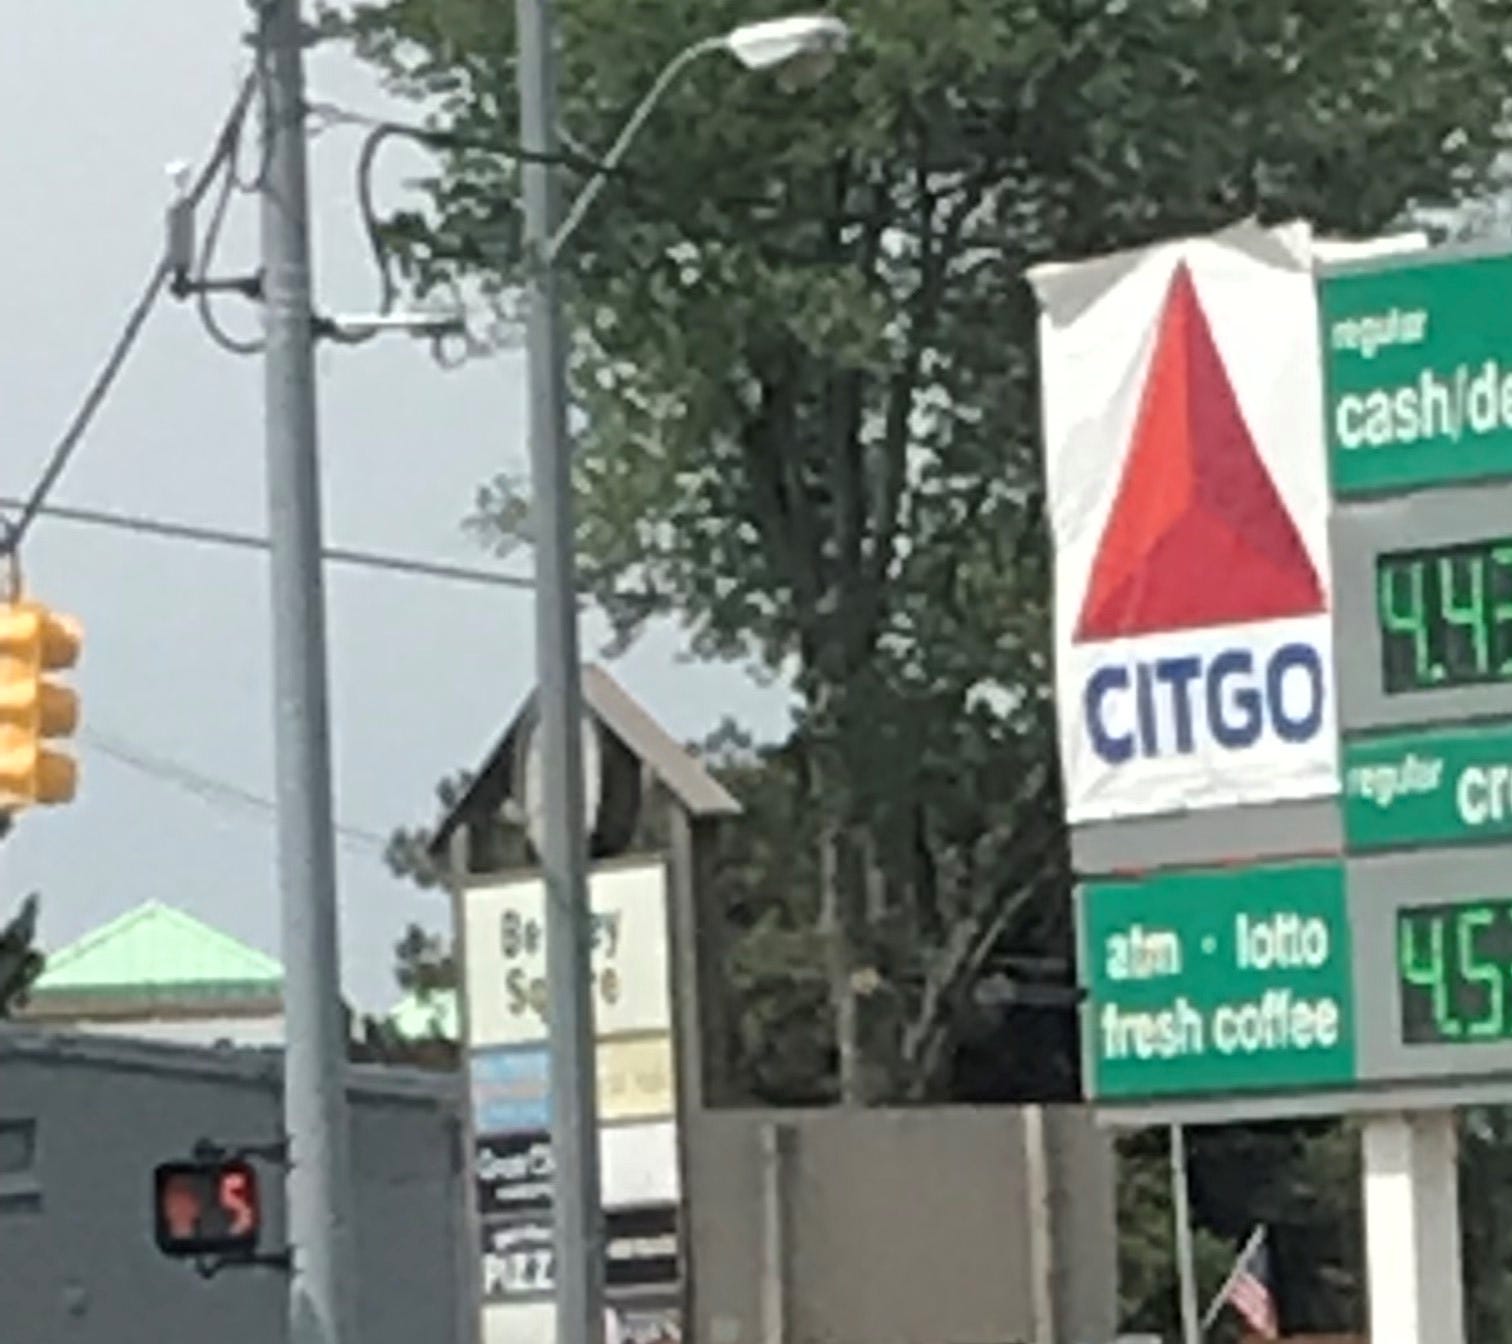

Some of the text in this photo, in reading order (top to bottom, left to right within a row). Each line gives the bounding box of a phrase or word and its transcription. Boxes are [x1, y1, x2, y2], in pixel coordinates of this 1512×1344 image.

[1084, 642, 1324, 766] CITGO
[1104, 912, 1329, 980] atm lotto
[1102, 987, 1339, 1060] fresh coffee
